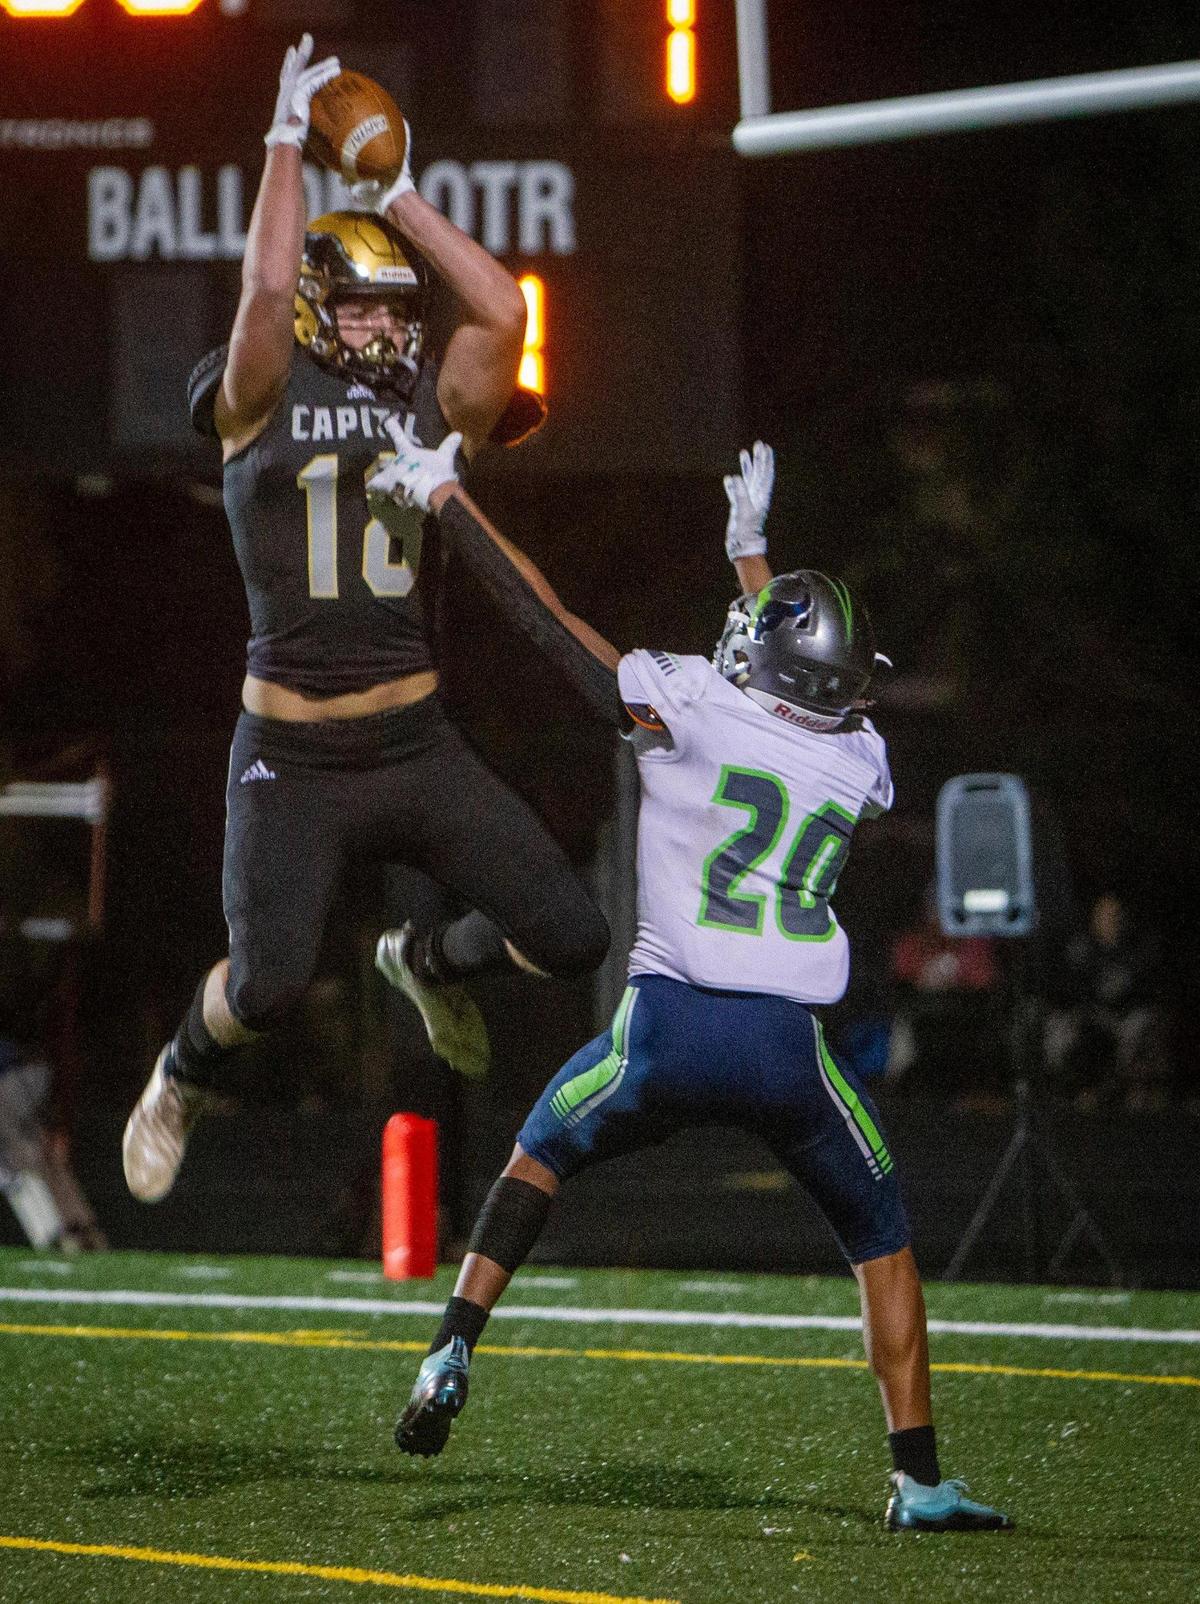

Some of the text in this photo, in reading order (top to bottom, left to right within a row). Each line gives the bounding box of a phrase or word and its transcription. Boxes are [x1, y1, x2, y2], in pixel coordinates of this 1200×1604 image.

[86, 163, 248, 262] BALL
[291, 403, 424, 450] CAPITL
[697, 764, 858, 943] 20
